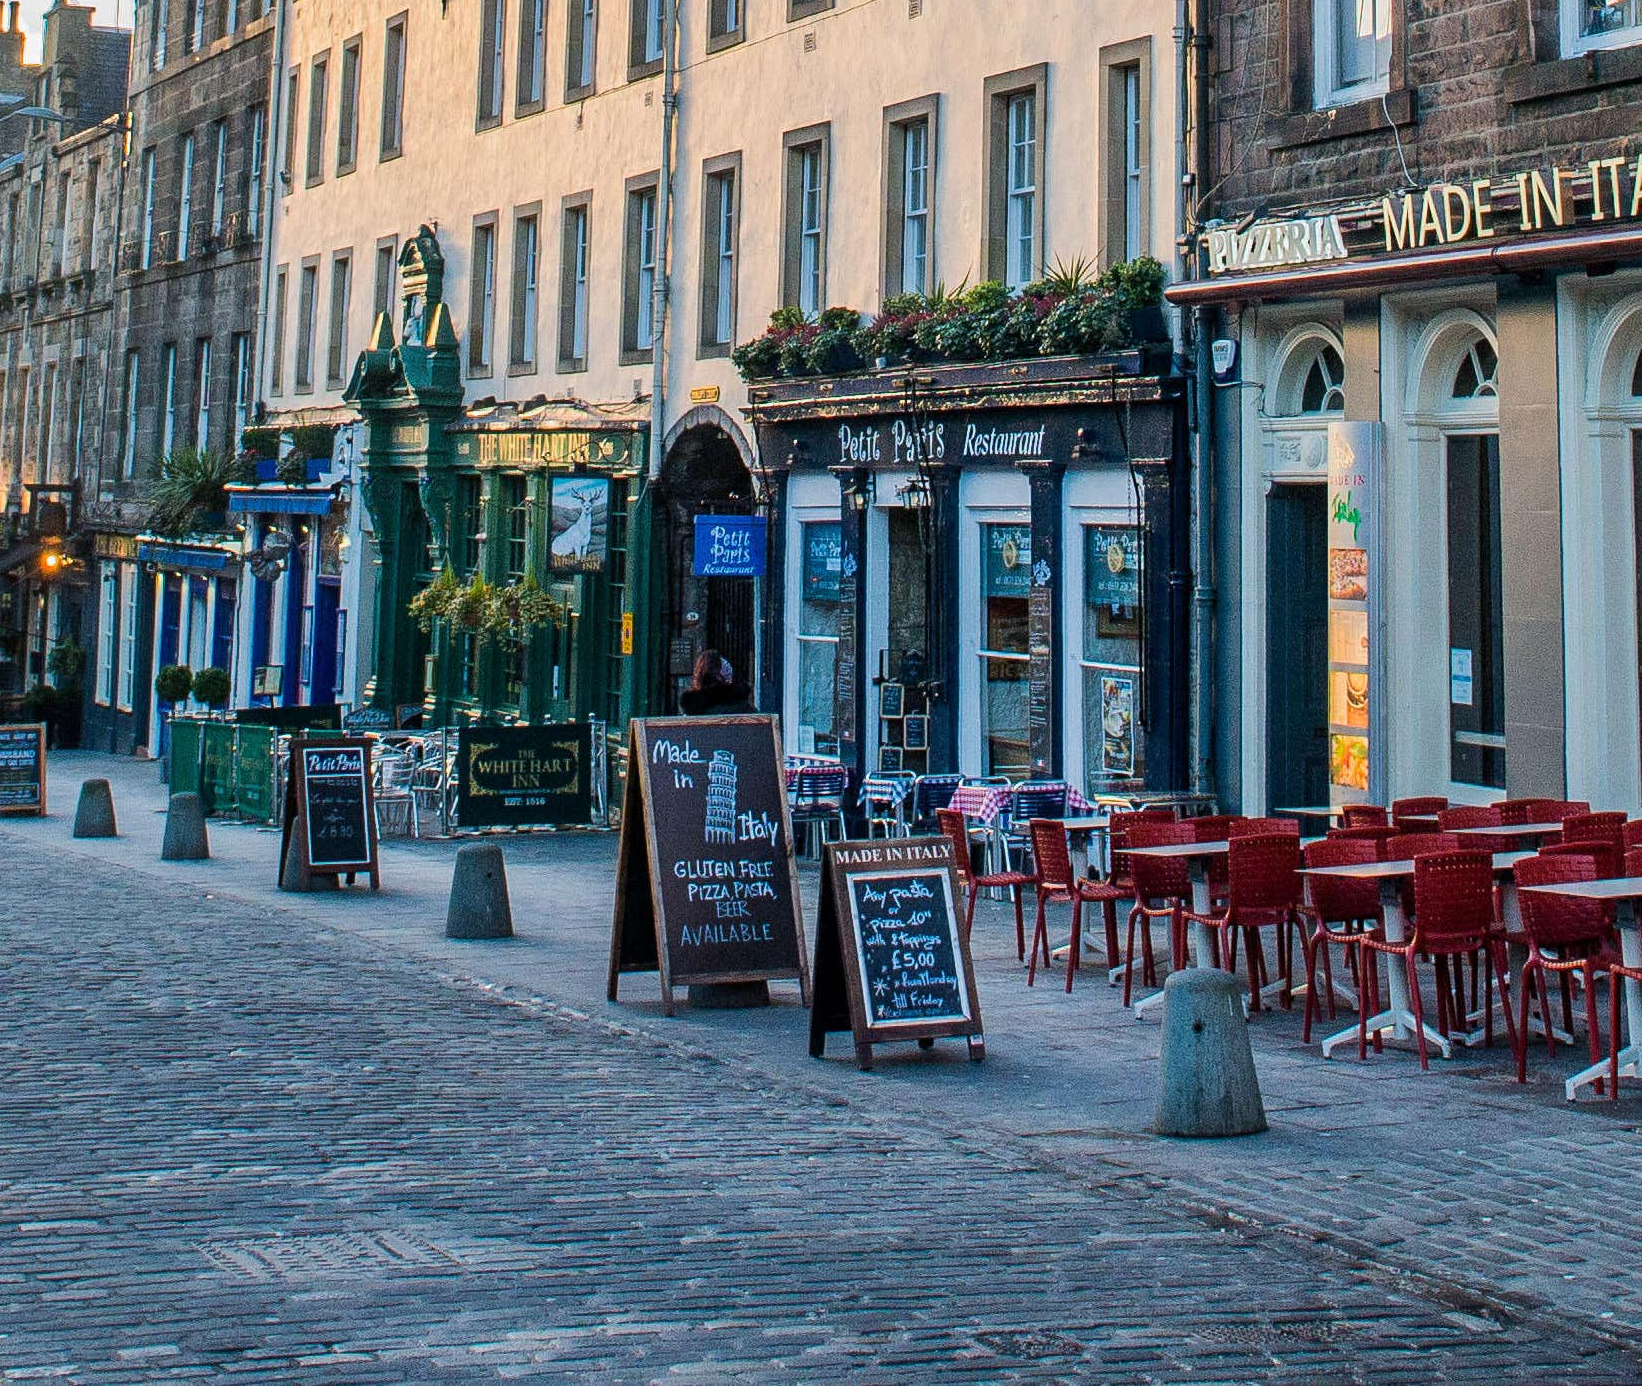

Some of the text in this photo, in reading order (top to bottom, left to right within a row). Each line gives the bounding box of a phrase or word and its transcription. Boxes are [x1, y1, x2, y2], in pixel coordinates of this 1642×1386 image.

[1208, 214, 1348, 272] PIZZERIA
[1382, 179, 1495, 251] MADE
[1516, 167, 1564, 230] IN
[478, 433, 590, 463] THE WHITE HART INN
[838, 419, 1046, 463] Petit Paris Restaurant
[710, 526, 750, 546] Petit
[710, 545, 750, 564] Paris
[703, 564, 754, 574] Restaurant
[653, 740, 708, 764] Made
[309, 753, 336, 772] Petit
[478, 758, 572, 774] WHITE HART
[512, 774, 540, 788] INN
[737, 810, 778, 846] Italy
[835, 844, 950, 864] MADE IN ITALY
[674, 859, 773, 878] GLUTEN FREE
[863, 879, 933, 908] Any pasta
[716, 901, 752, 918] BEER
[681, 923, 773, 946] AVAILABLE
[869, 917, 906, 934] pizza
[866, 933, 886, 946] with
[898, 931, 942, 950] toppings
[910, 990, 944, 1008] Friday
